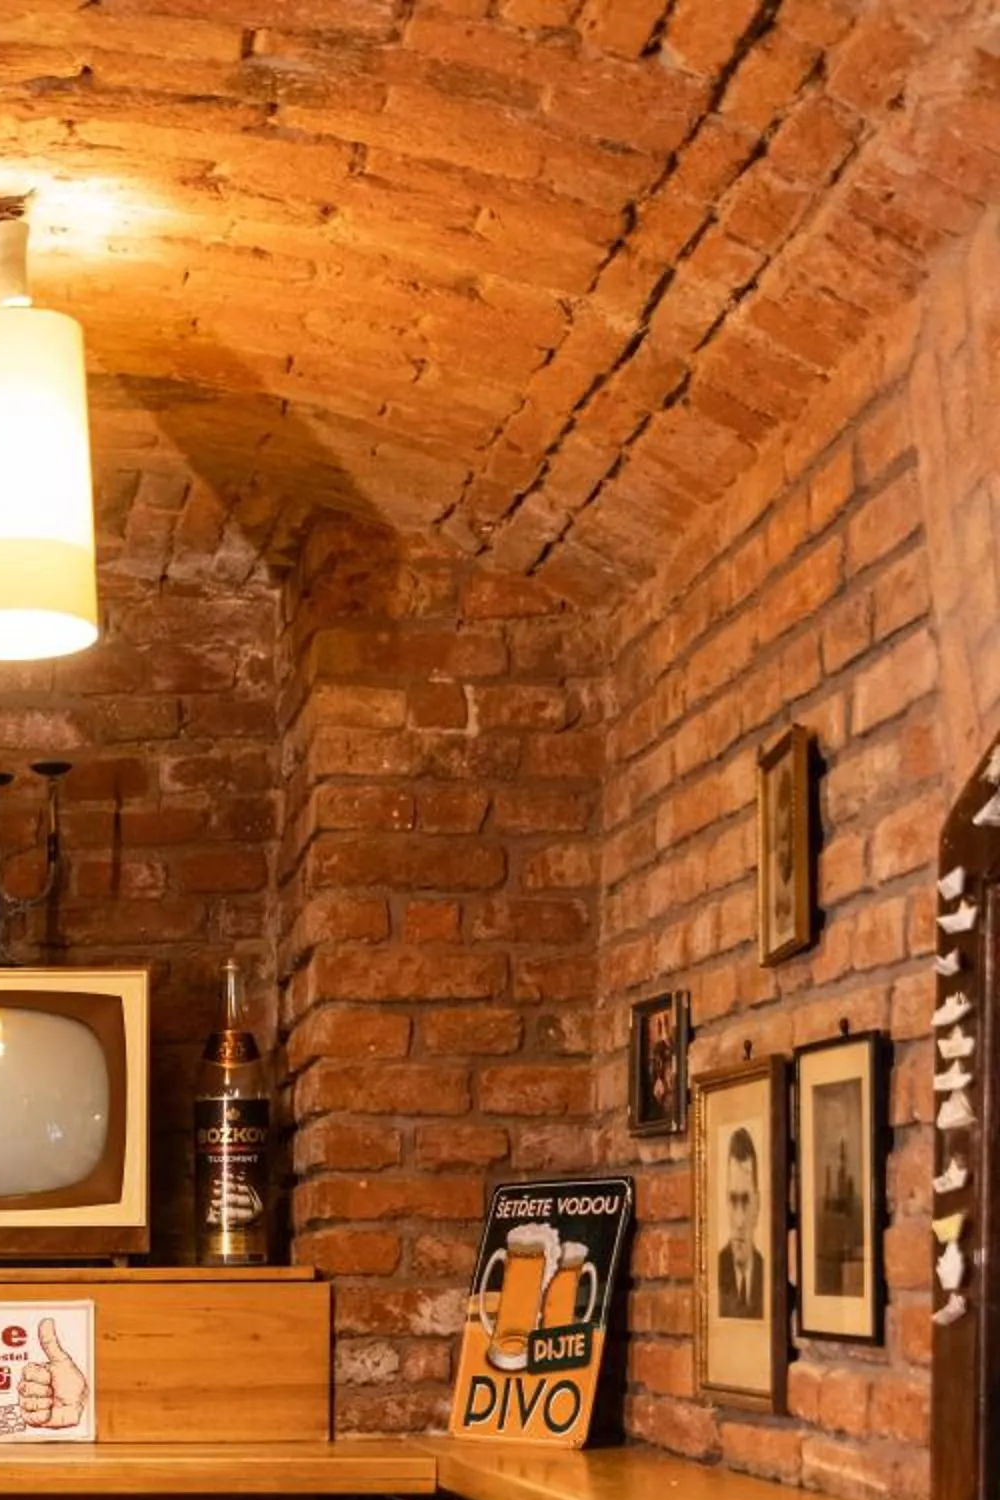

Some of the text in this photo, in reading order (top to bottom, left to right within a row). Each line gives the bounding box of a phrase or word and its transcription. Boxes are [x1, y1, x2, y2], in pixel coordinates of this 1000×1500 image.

[496, 1195, 619, 1219] ŠETŘETE VODOU
[463, 1375, 582, 1434] PIVO
